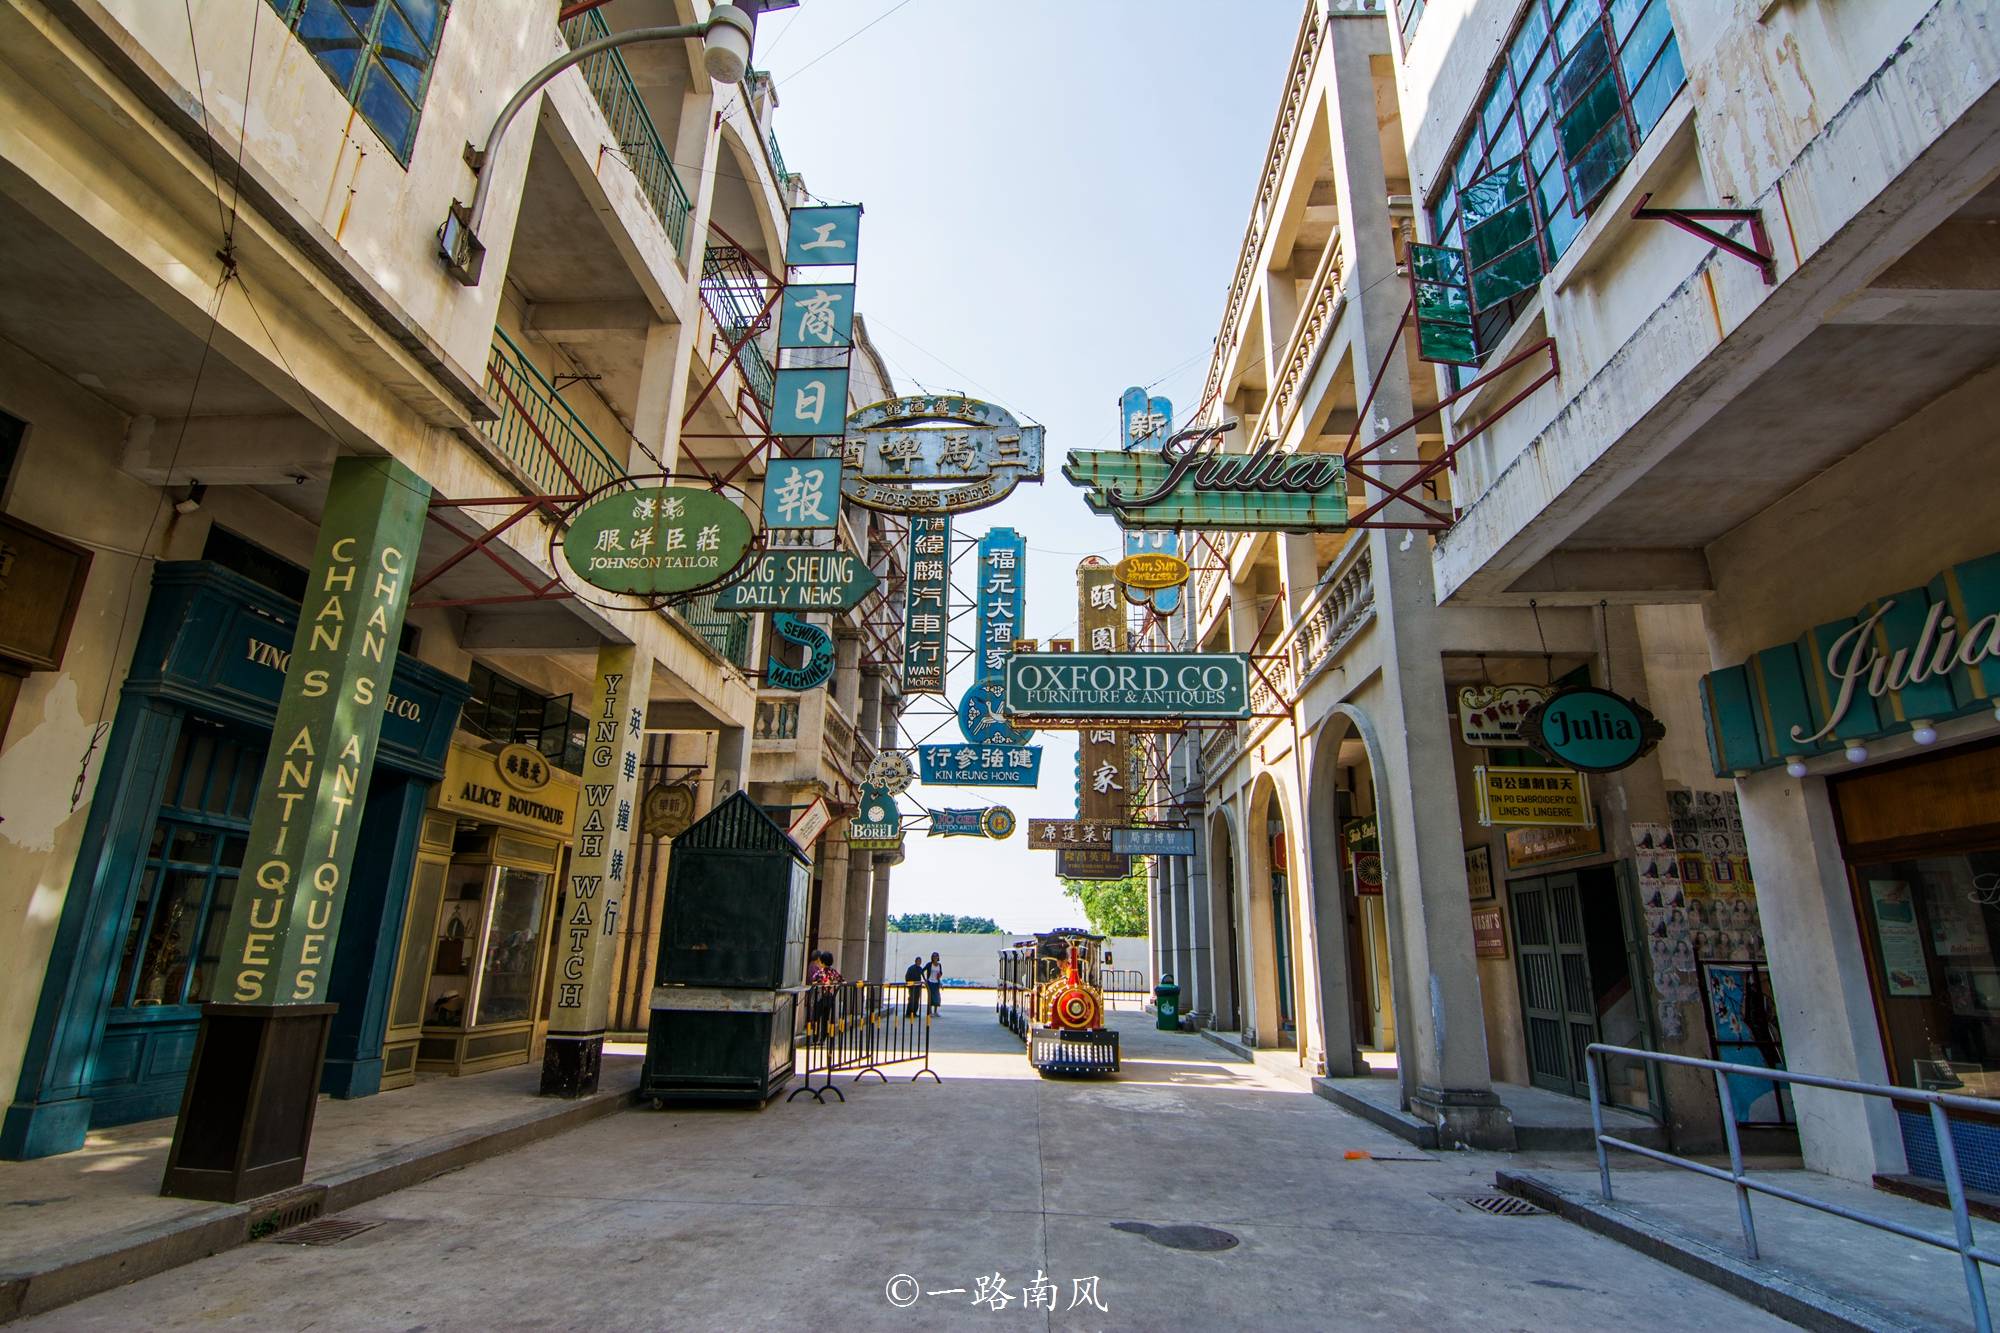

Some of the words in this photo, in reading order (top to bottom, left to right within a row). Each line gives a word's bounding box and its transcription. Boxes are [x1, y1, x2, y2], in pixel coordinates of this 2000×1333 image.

[774, 222, 846, 522] 工商日報
[1107, 416, 1338, 506] Julia
[874, 490, 940, 507] HORSES
[945, 484, 994, 506] BEER
[589, 557, 658, 571] JOHNSON
[665, 556, 719, 569] TAILOR
[787, 556, 853, 583] SHEUNG
[309, 538, 356, 651] CHAN
[361, 547, 402, 663] CHAN
[736, 586, 790, 605] DAILY
[800, 586, 842, 604] NEWS
[784, 621, 823, 649] SEWING
[770, 652, 830, 687] MACHINES
[909, 666, 940, 675] WANS
[1017, 665, 1169, 692] OXFORD
[1178, 666, 1237, 692] CO.
[398, 700, 421, 722] CO.
[1027, 691, 1120, 704] FURNITURE
[1125, 691, 1137, 704] &
[1141, 690, 1225, 706] ANTIQUES
[593, 675, 623, 767] YING
[1551, 710, 1634, 747] Julia
[935, 771, 952, 780] KIN
[956, 771, 988, 780] KEUNG
[991, 771, 1020, 781] HONG
[460, 782, 502, 809] ALICE
[507, 795, 564, 825] BOUTIQUE
[1499, 807, 1530, 816] LINENS
[1533, 807, 1573, 817] LINGERIE
[1516, 795, 1565, 804] EMBROIDERY
[580, 785, 614, 857] WAH
[854, 824, 897, 838] BOREL
[234, 726, 315, 1001] ANTIQUES
[292, 735, 361, 1000] ANTIQUES
[559, 876, 601, 1007] WATCH
